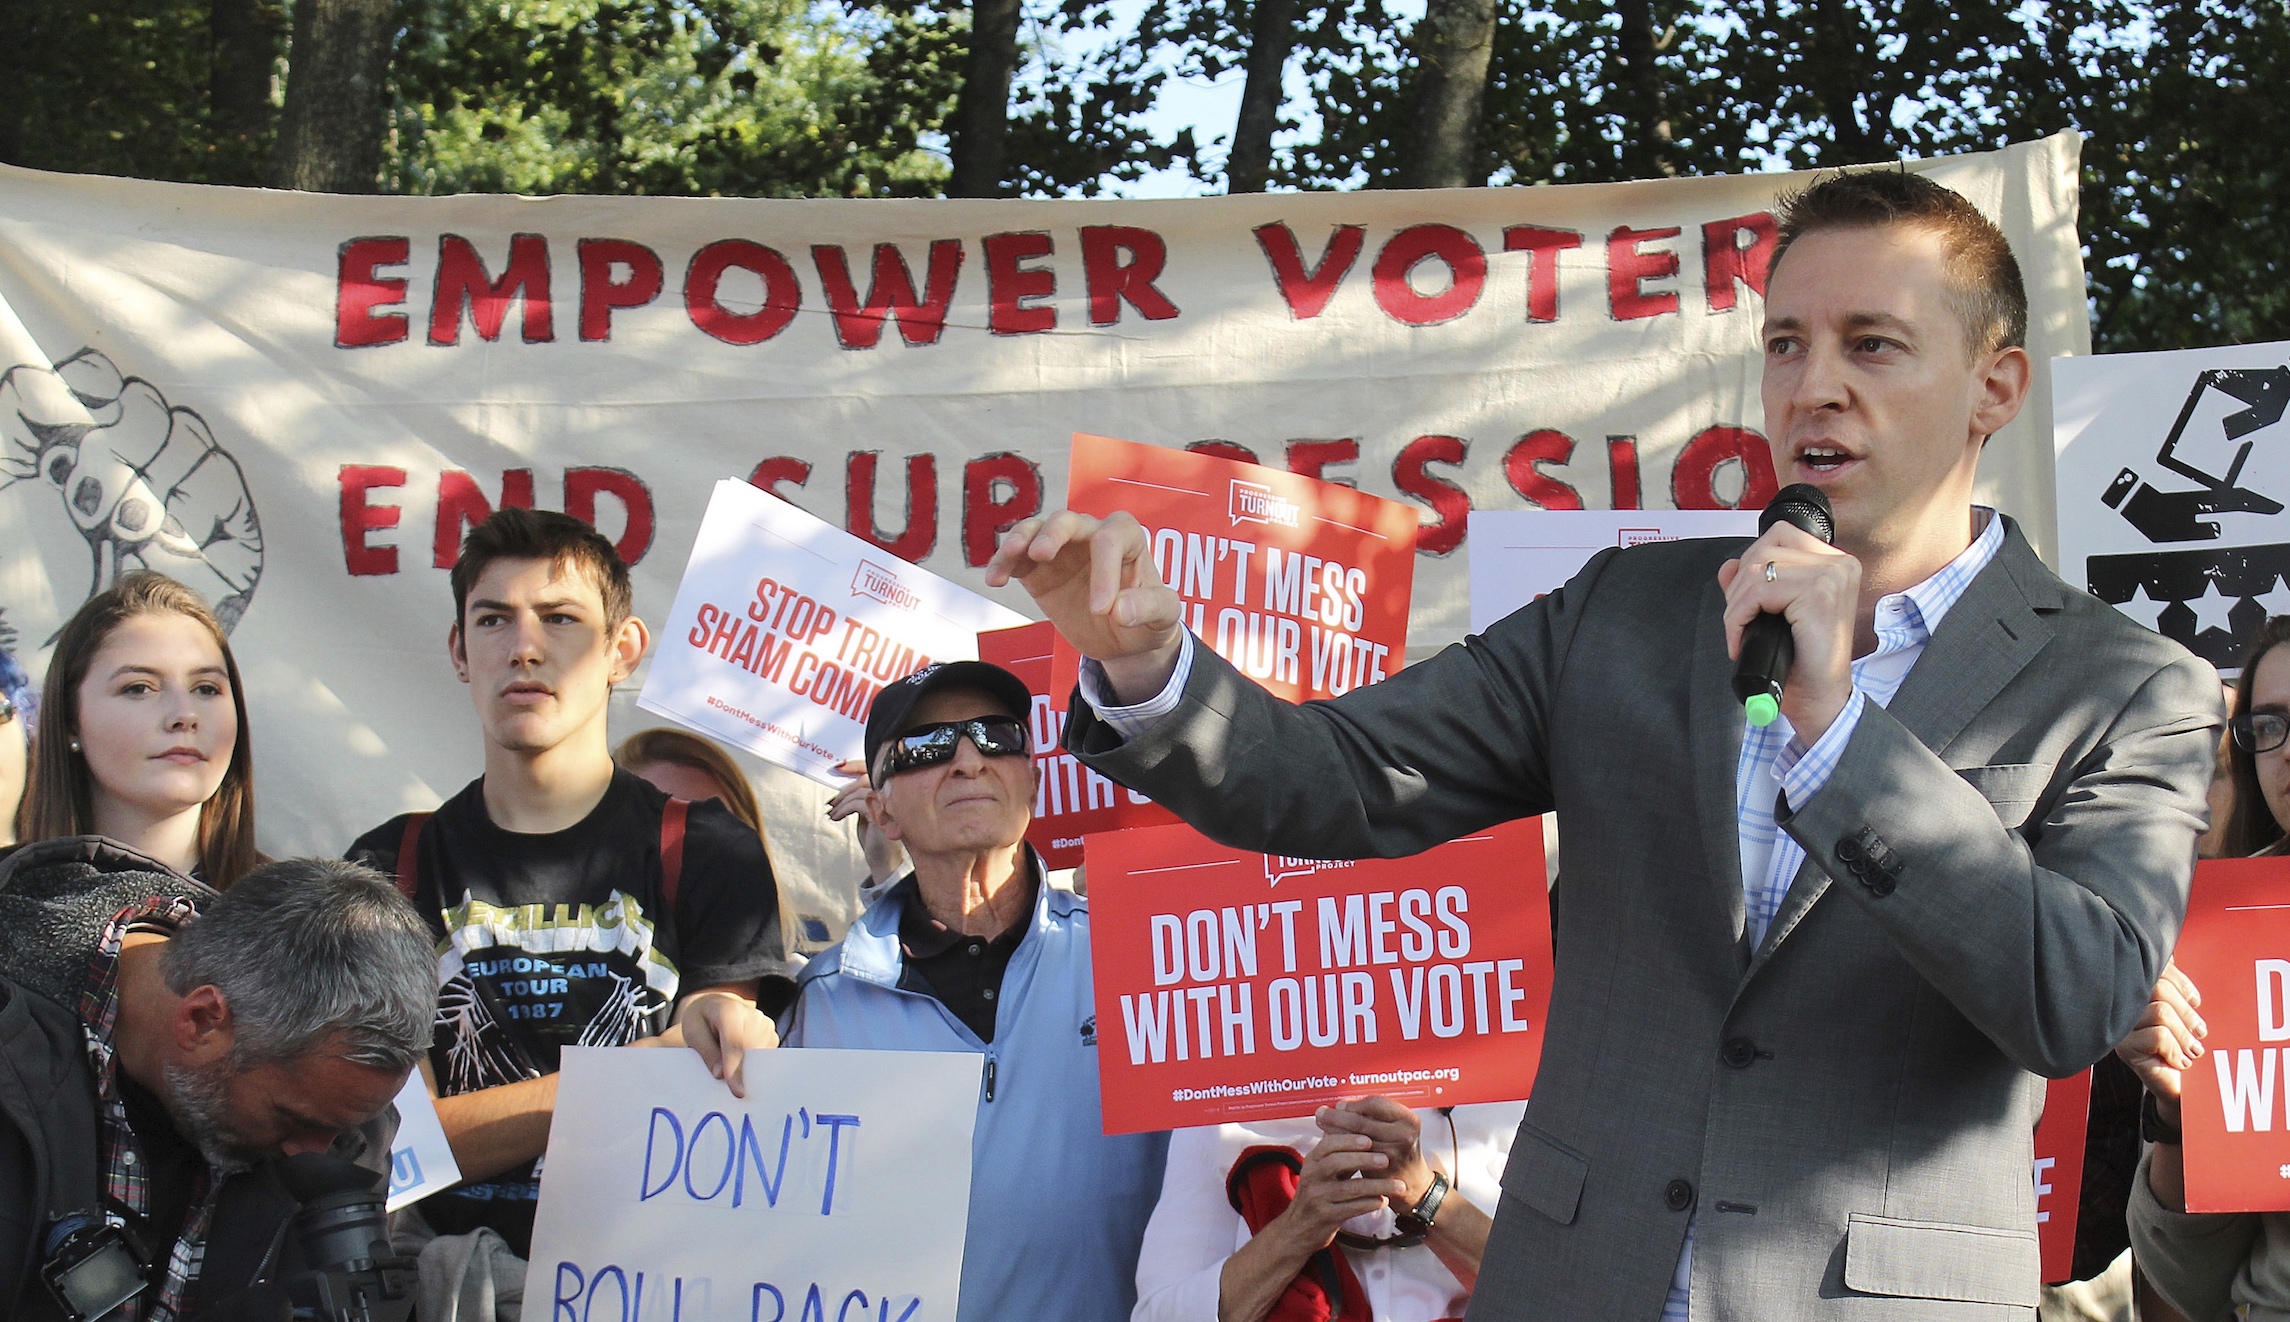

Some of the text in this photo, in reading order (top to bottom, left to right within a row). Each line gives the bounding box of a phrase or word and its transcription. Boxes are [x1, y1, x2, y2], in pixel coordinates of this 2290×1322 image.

[334, 224, 1180, 350] EMPOWER
[337, 464, 656, 576] END
[1239, 495, 1300, 522] TURNOUT
[864, 574, 921, 611] TURNOUT
[1141, 525, 1255, 605] ON'T
[1264, 547, 1366, 632] MESS
[688, 603, 794, 684] SHAM
[748, 577, 934, 682] STOP TRUM
[1216, 608, 1301, 685] OUR
[1311, 625, 1389, 697] VOTE
[706, 695, 834, 760] #DontMessWithOurVote
[1316, 860, 1355, 870] PROJECT
[466, 957, 608, 979] EUROPEAN
[1150, 885, 1471, 986] DON'T MESS
[500, 978, 569, 996] TOUR
[1120, 959, 1528, 1066] WITH OUR VOTE
[1172, 1074, 1338, 1102] #DontMessWithOurVote
[1349, 1066, 1460, 1087] turnoutpac.org
[640, 1106, 861, 1216] DON'T
